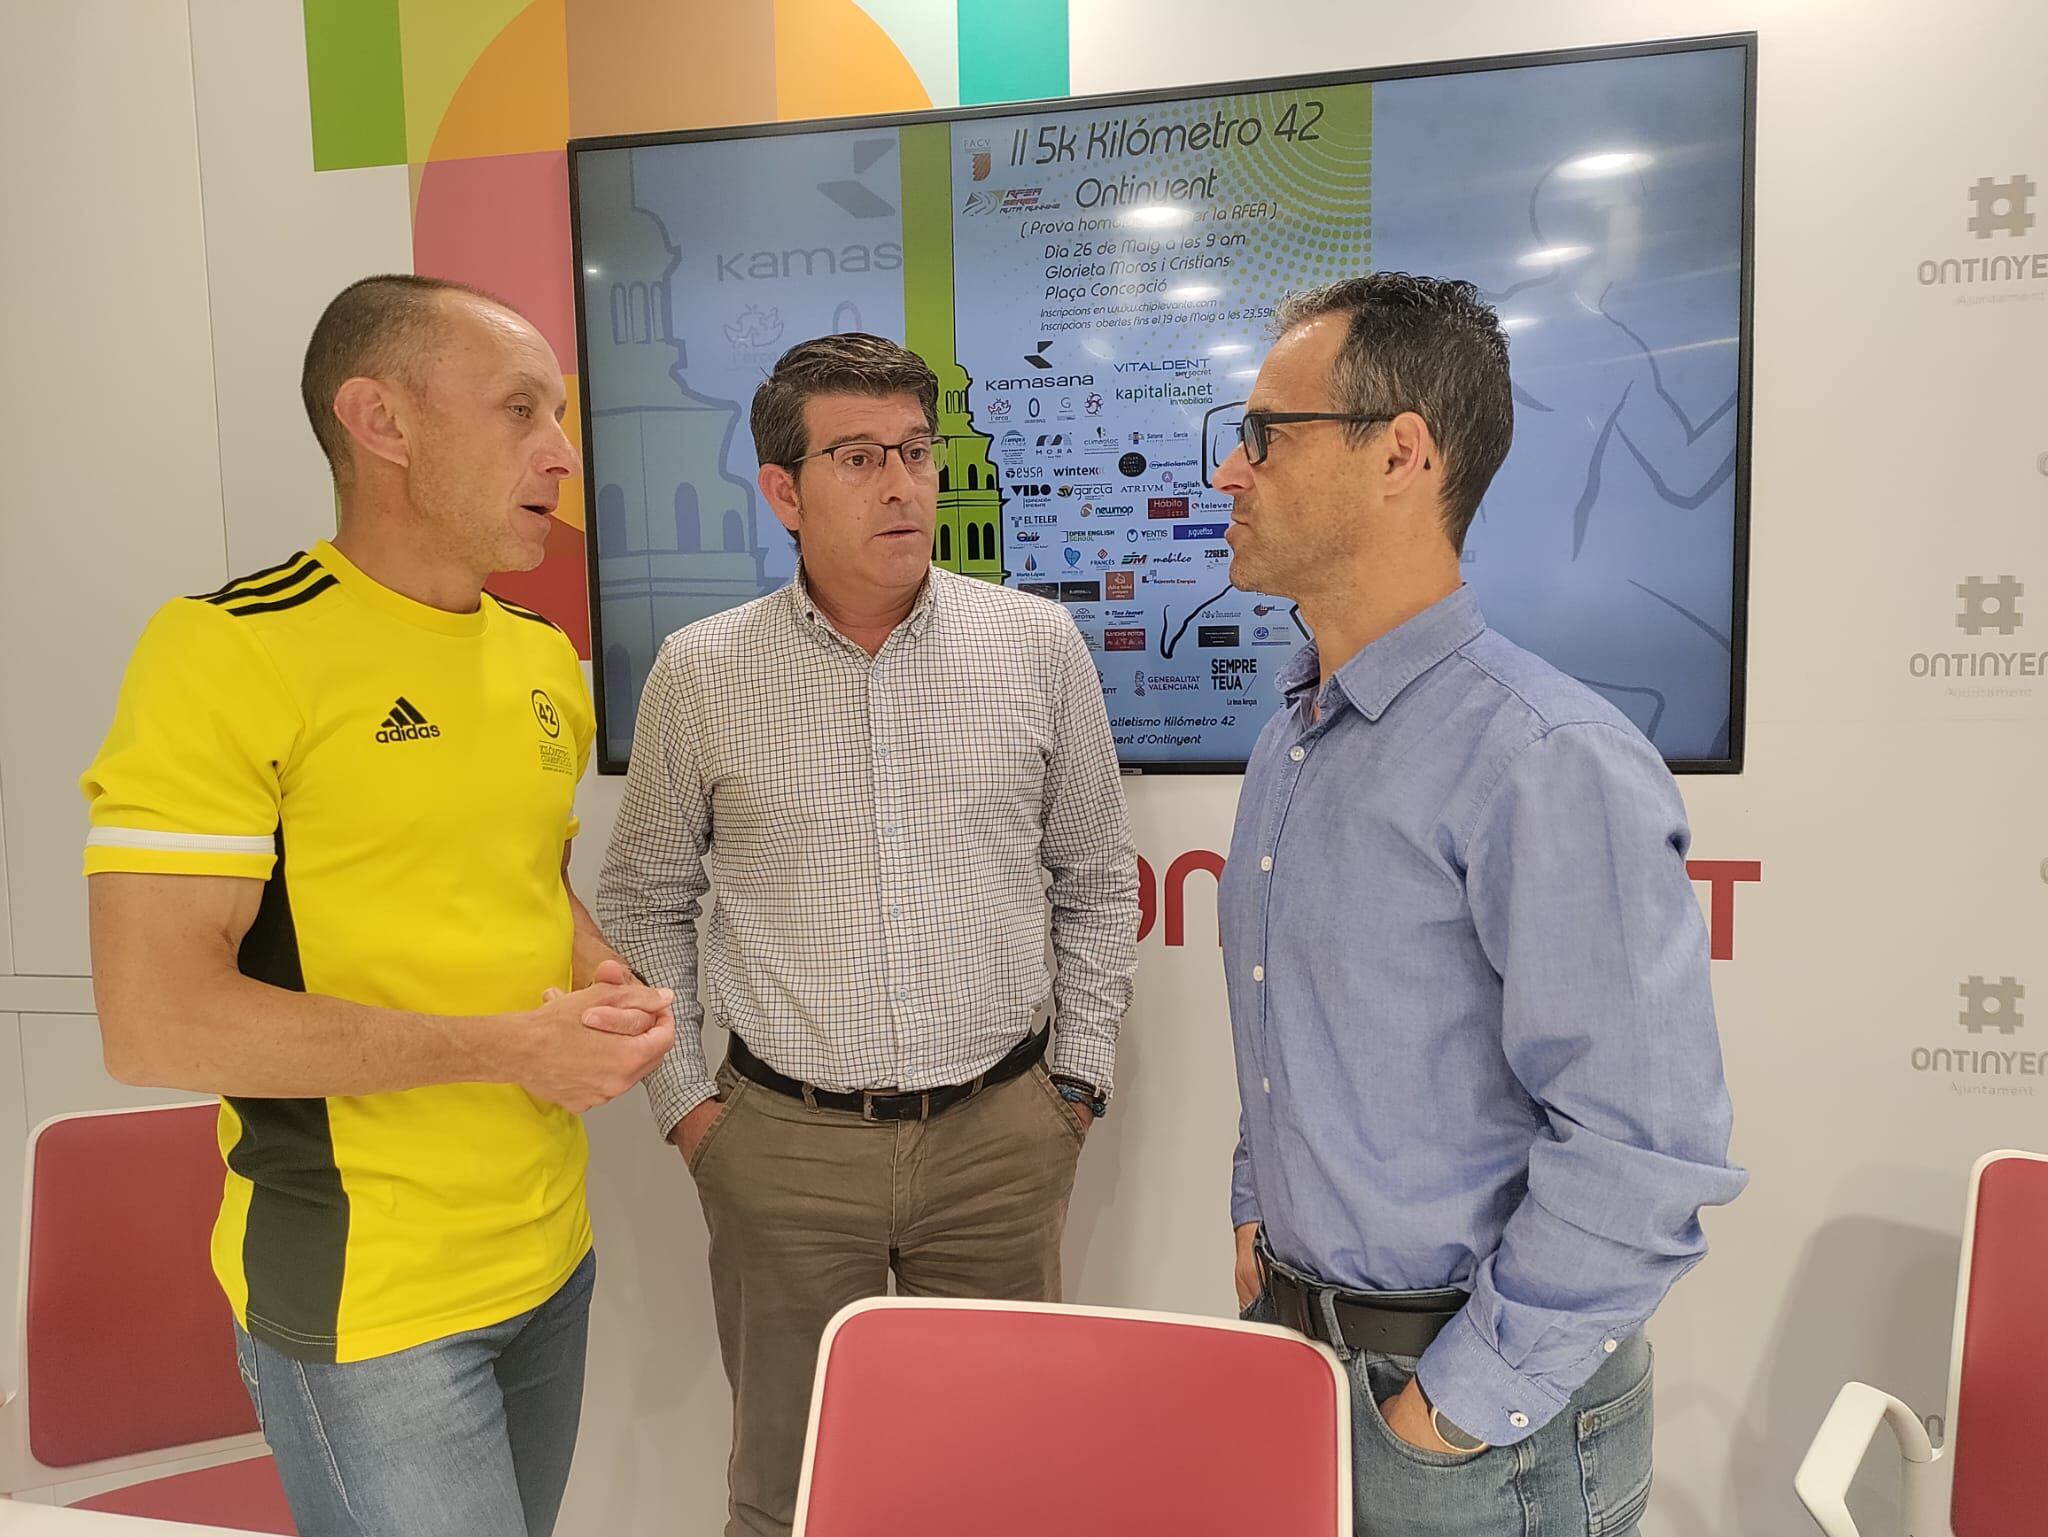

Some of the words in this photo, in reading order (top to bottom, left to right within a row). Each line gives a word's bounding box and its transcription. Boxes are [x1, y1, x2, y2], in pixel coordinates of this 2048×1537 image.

[1036, 126, 1077, 165] 5k
[1087, 110, 1262, 159] Kilómetro
[1274, 102, 1324, 143] 42
[1076, 168, 1218, 208] Ontinyent
[1213, 207, 1227, 220] la
[1044, 244, 1069, 259] Dia
[1074, 242, 1092, 257] 26
[1097, 241, 1117, 255] de
[1121, 238, 1160, 254] Maig
[1166, 240, 1175, 250] a
[1181, 237, 1200, 249] les
[1206, 233, 1216, 247] 9
[1220, 234, 1246, 246] am
[1045, 263, 1105, 279] Glorieta
[1110, 261, 1157, 275] Moros
[1161, 257, 1166, 271] i
[1170, 255, 1231, 270] Cristians
[1045, 285, 1086, 302] Plaça
[1091, 279, 1168, 297] Concepció
[1040, 307, 1091, 319] Inscripcions
[1093, 306, 1106, 314] en
[1040, 320, 1091, 332] Inscripcions
[1096, 318, 1131, 328] obertes
[1133, 316, 1149, 326] fins
[1151, 314, 1161, 325] el
[1162, 313, 1173, 324] 19
[1175, 312, 1188, 323] de
[1190, 311, 1216, 323] Maig
[1228, 311, 1241, 320] les
[1113, 358, 1211, 373] VITALDENT
[1011, 484, 1051, 496] VIBO
[1173, 480, 1201, 490] English
[1024, 516, 1034, 524] EL
[1141, 529, 1168, 538] VENTIS
[1211, 658, 1257, 674] SEMPRE
[1148, 675, 1200, 683] GENERALITAT
[1211, 676, 1243, 691] TEUA
[1148, 683, 1200, 691] VALENCIANA
[539, 702, 557, 726] 42
[1110, 716, 1161, 727] atletismo
[1164, 715, 1218, 727] Kilómetro
[1221, 716, 1236, 726] 42
[375, 723, 441, 744] adidas
[1137, 733, 1202, 746] d'Ontinyent
